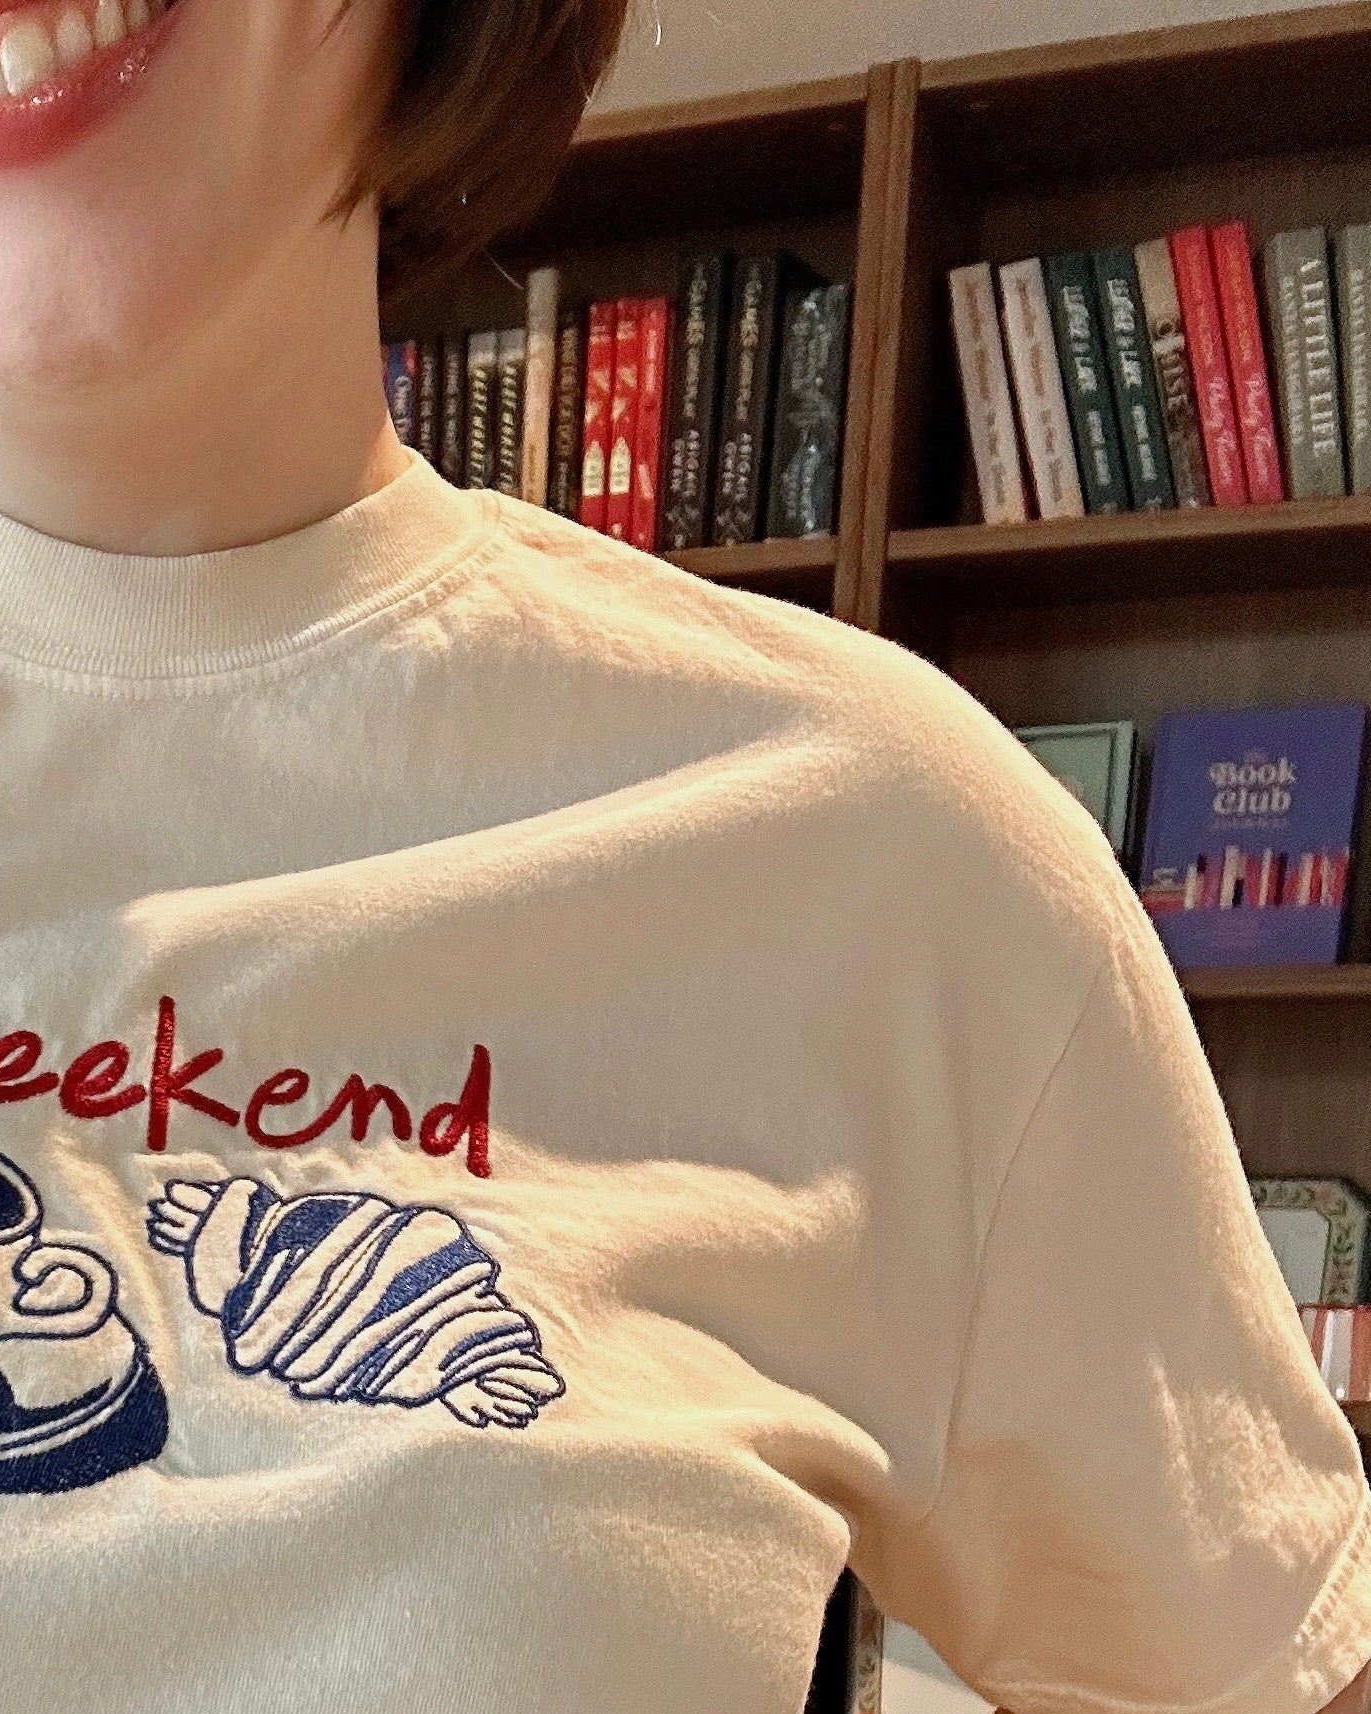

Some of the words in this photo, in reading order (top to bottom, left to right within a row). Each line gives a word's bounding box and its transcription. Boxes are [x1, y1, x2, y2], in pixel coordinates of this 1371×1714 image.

[1300, 258, 1322, 277] A
[1300, 280, 1332, 387] LITTLE
[1309, 391, 1337, 458] LIFE
[1208, 758, 1298, 787] Book
[1211, 785, 1293, 816] Club
